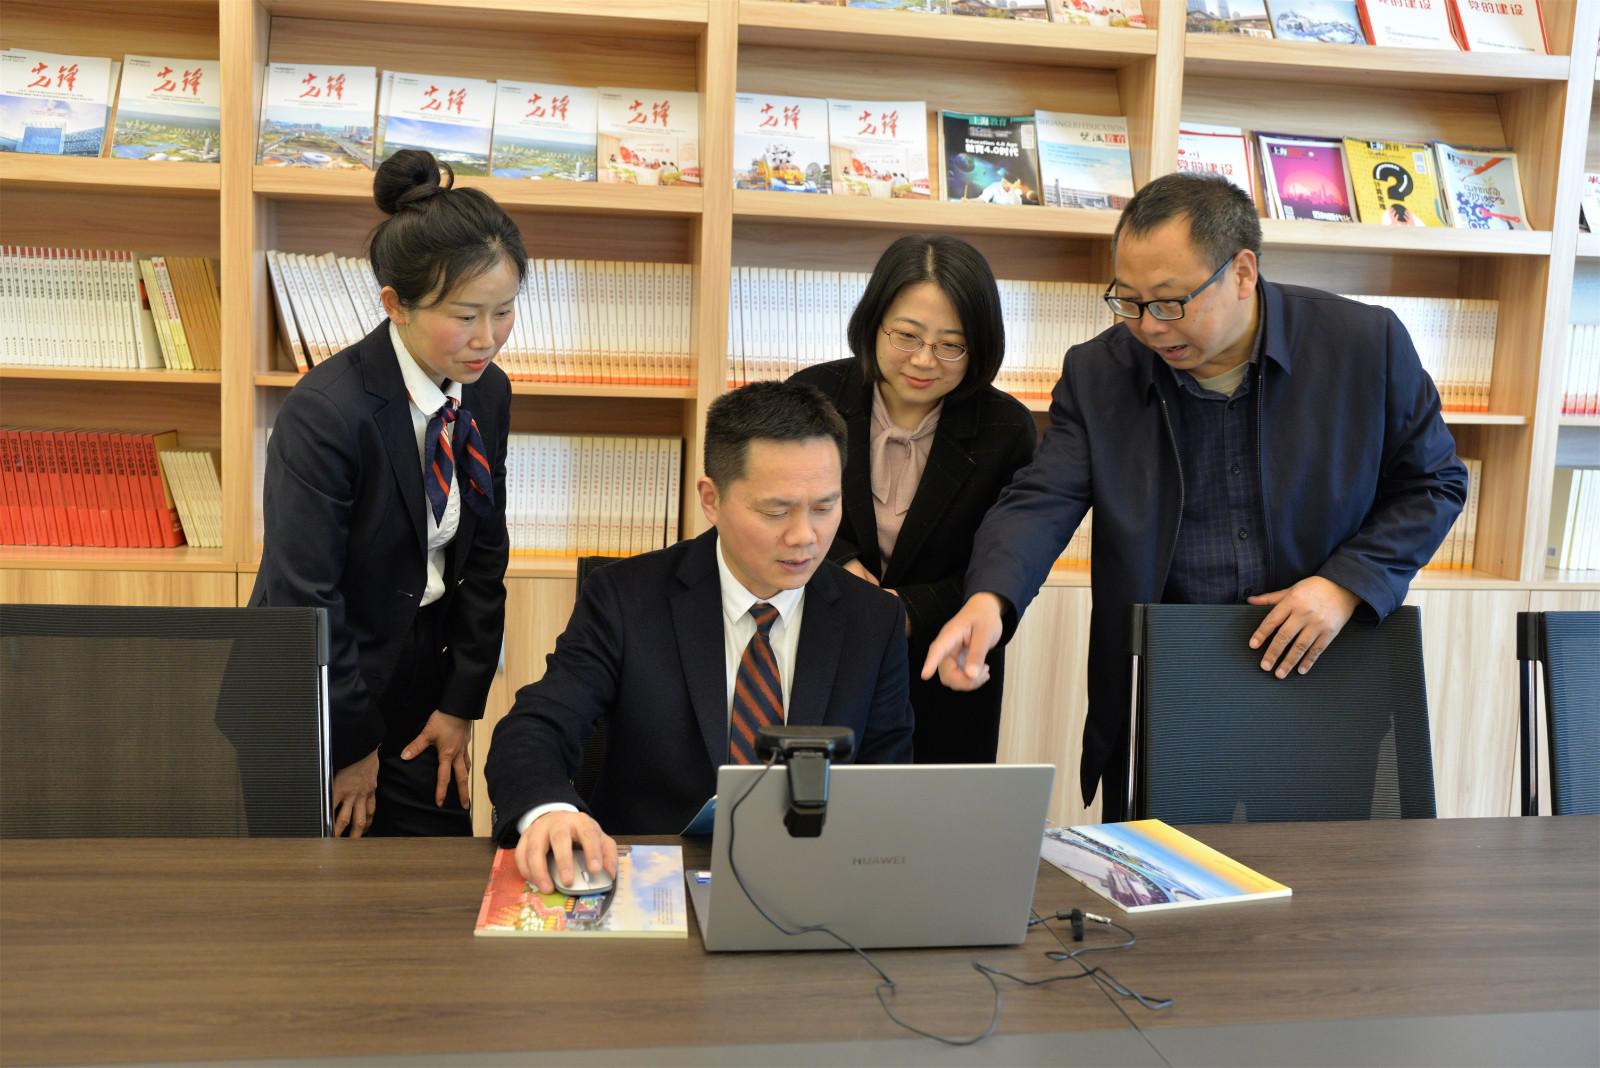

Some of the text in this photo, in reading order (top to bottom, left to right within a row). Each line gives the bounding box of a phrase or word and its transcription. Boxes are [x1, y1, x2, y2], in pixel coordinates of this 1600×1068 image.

[27, 62, 79, 91] 先锋
[153, 66, 203, 96] 先锋
[299, 73, 346, 100] 先锋
[420, 85, 467, 114] 先锋
[525, 93, 570, 121] 先锋
[627, 100, 671, 127] 先锋
[759, 103, 801, 130] 先锋
[858, 110, 899, 137] 先锋
[852, 856, 906, 865] HUAWEI
